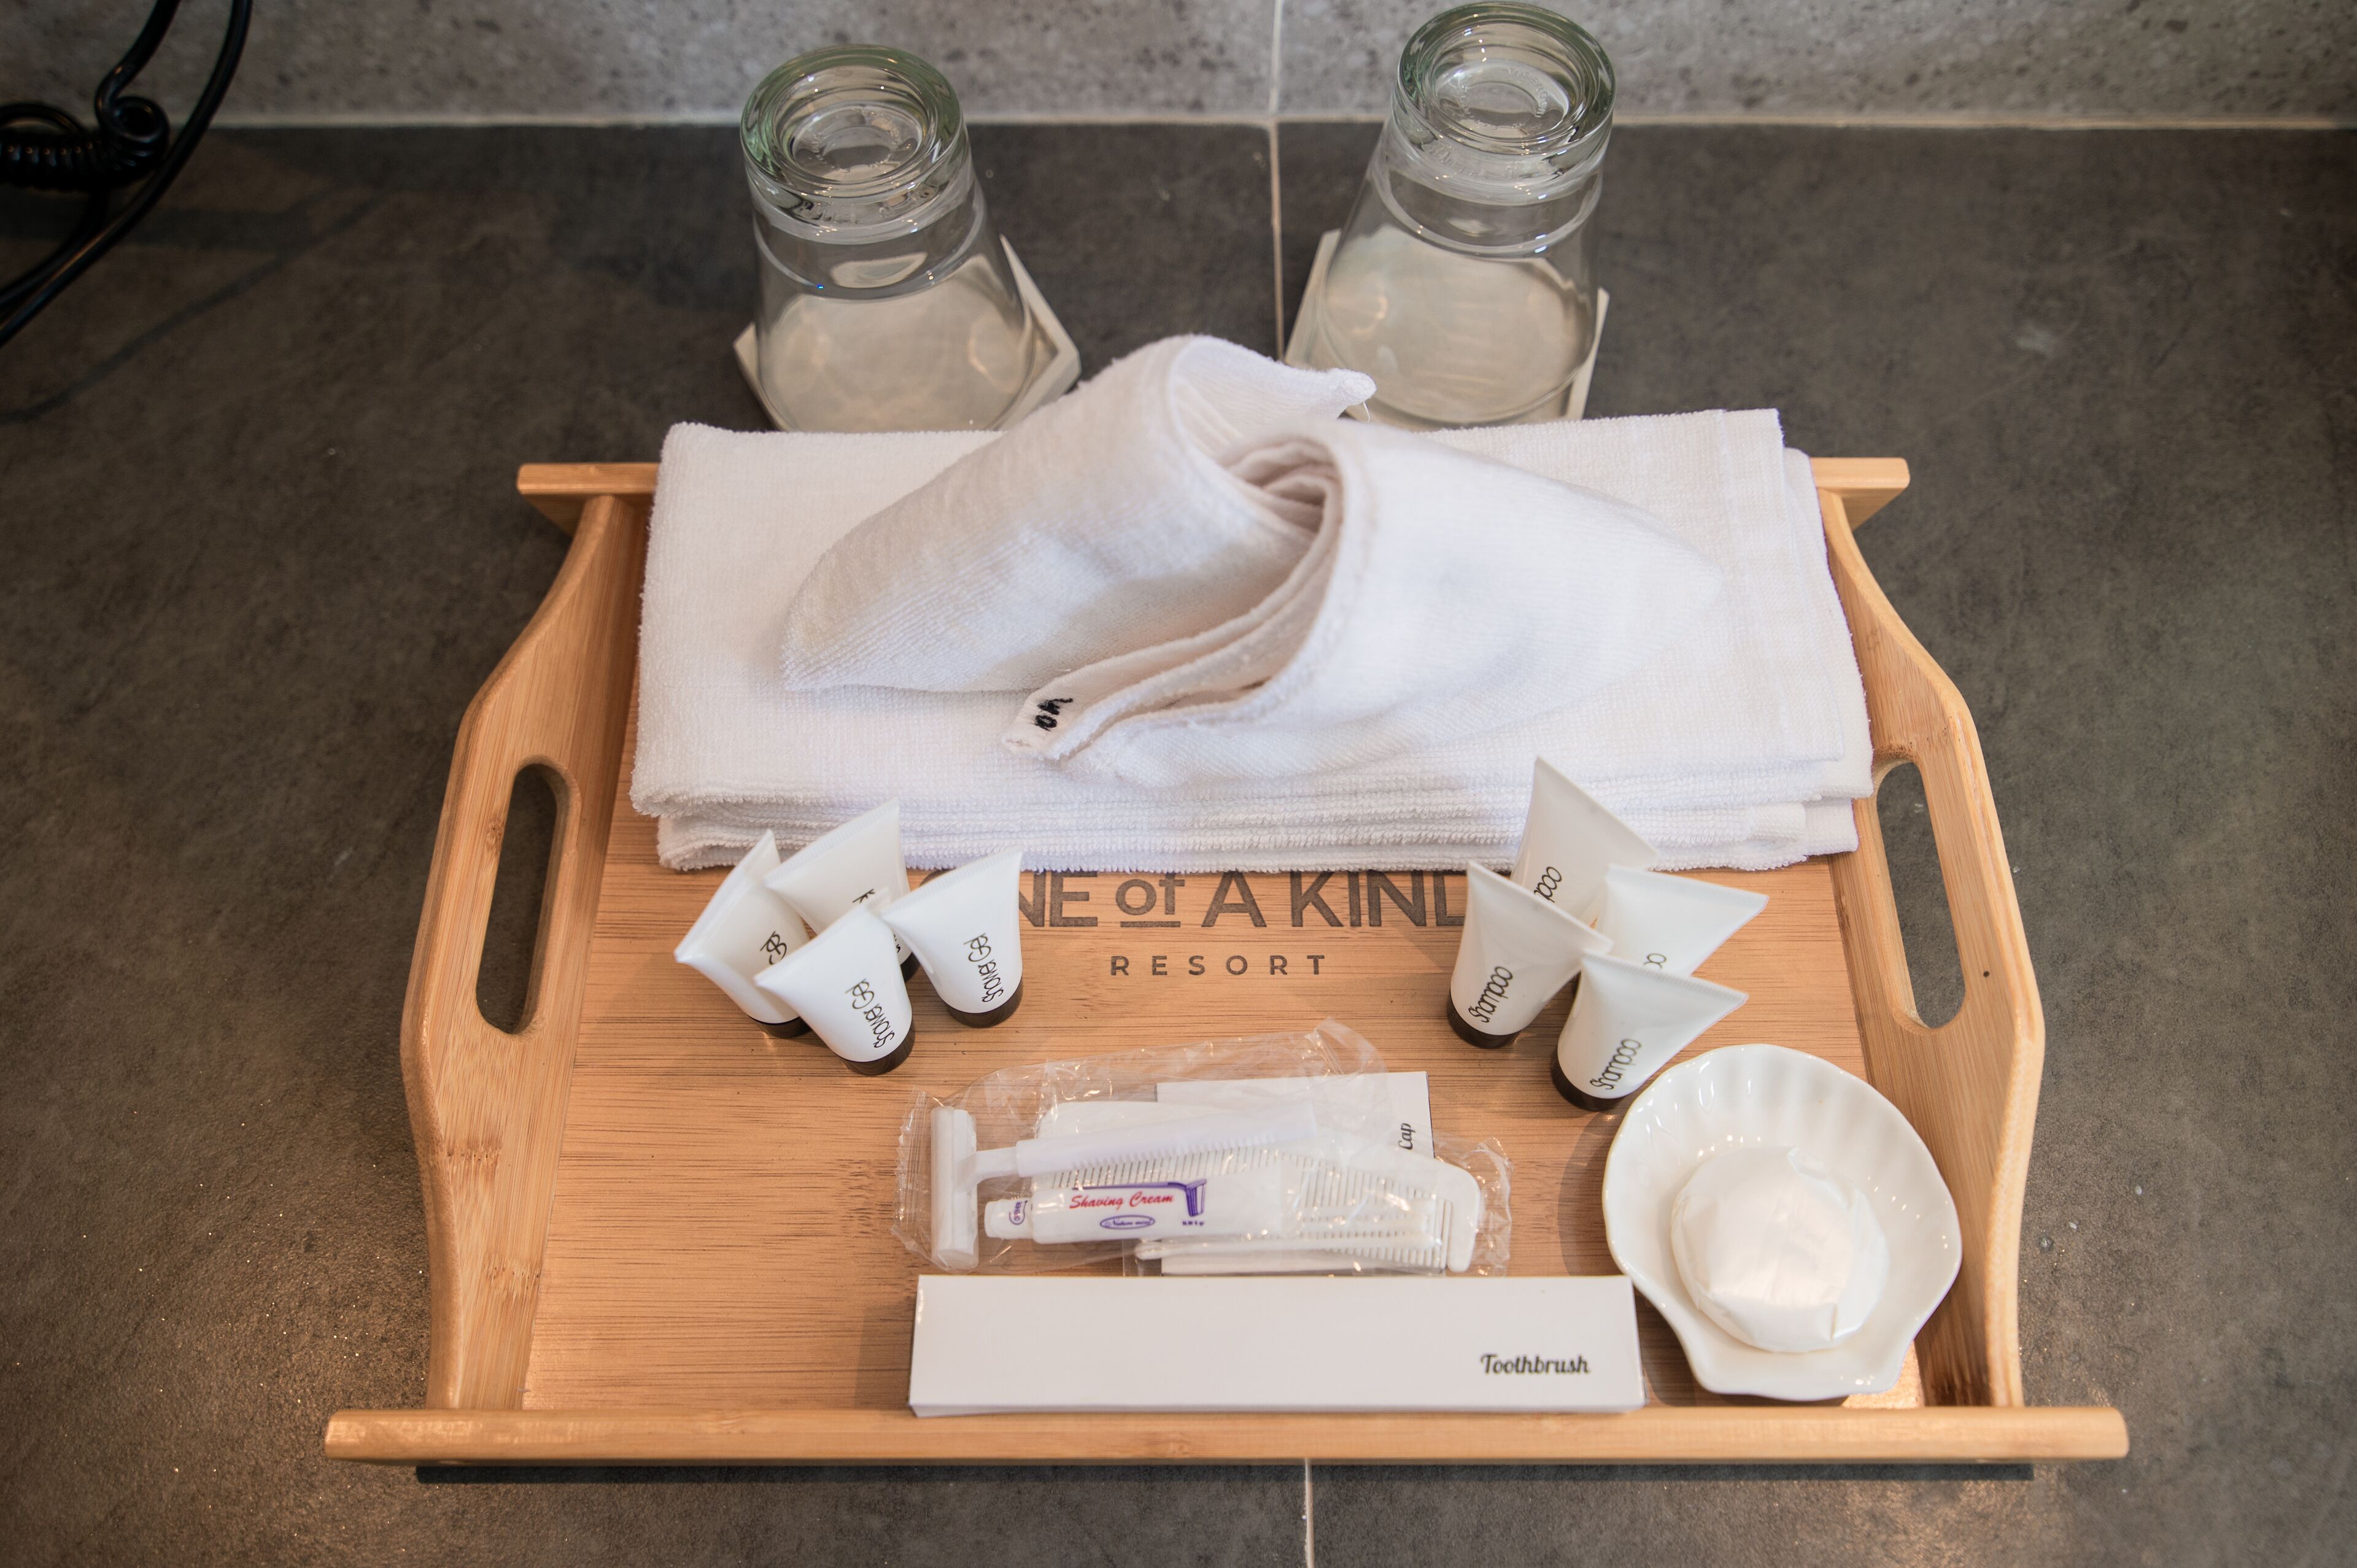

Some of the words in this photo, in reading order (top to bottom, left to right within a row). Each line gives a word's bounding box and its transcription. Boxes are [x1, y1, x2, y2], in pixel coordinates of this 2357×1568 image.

[1201, 871, 1267, 928] A
[963, 933, 991, 962] Gel
[977, 959, 1004, 1003] Shower
[1110, 954, 1325, 976] RESORT
[845, 978, 875, 1010] Gel
[1468, 966, 1513, 1024] Shampoo
[863, 1003, 895, 1048] Shower
[1589, 1038, 1642, 1091] Shampoo
[1398, 1123, 1416, 1151] Cap
[1069, 1194, 1124, 1210] Shaving
[1128, 1190, 1174, 1208] Cream
[1480, 1354, 1590, 1374] Toothbrush
